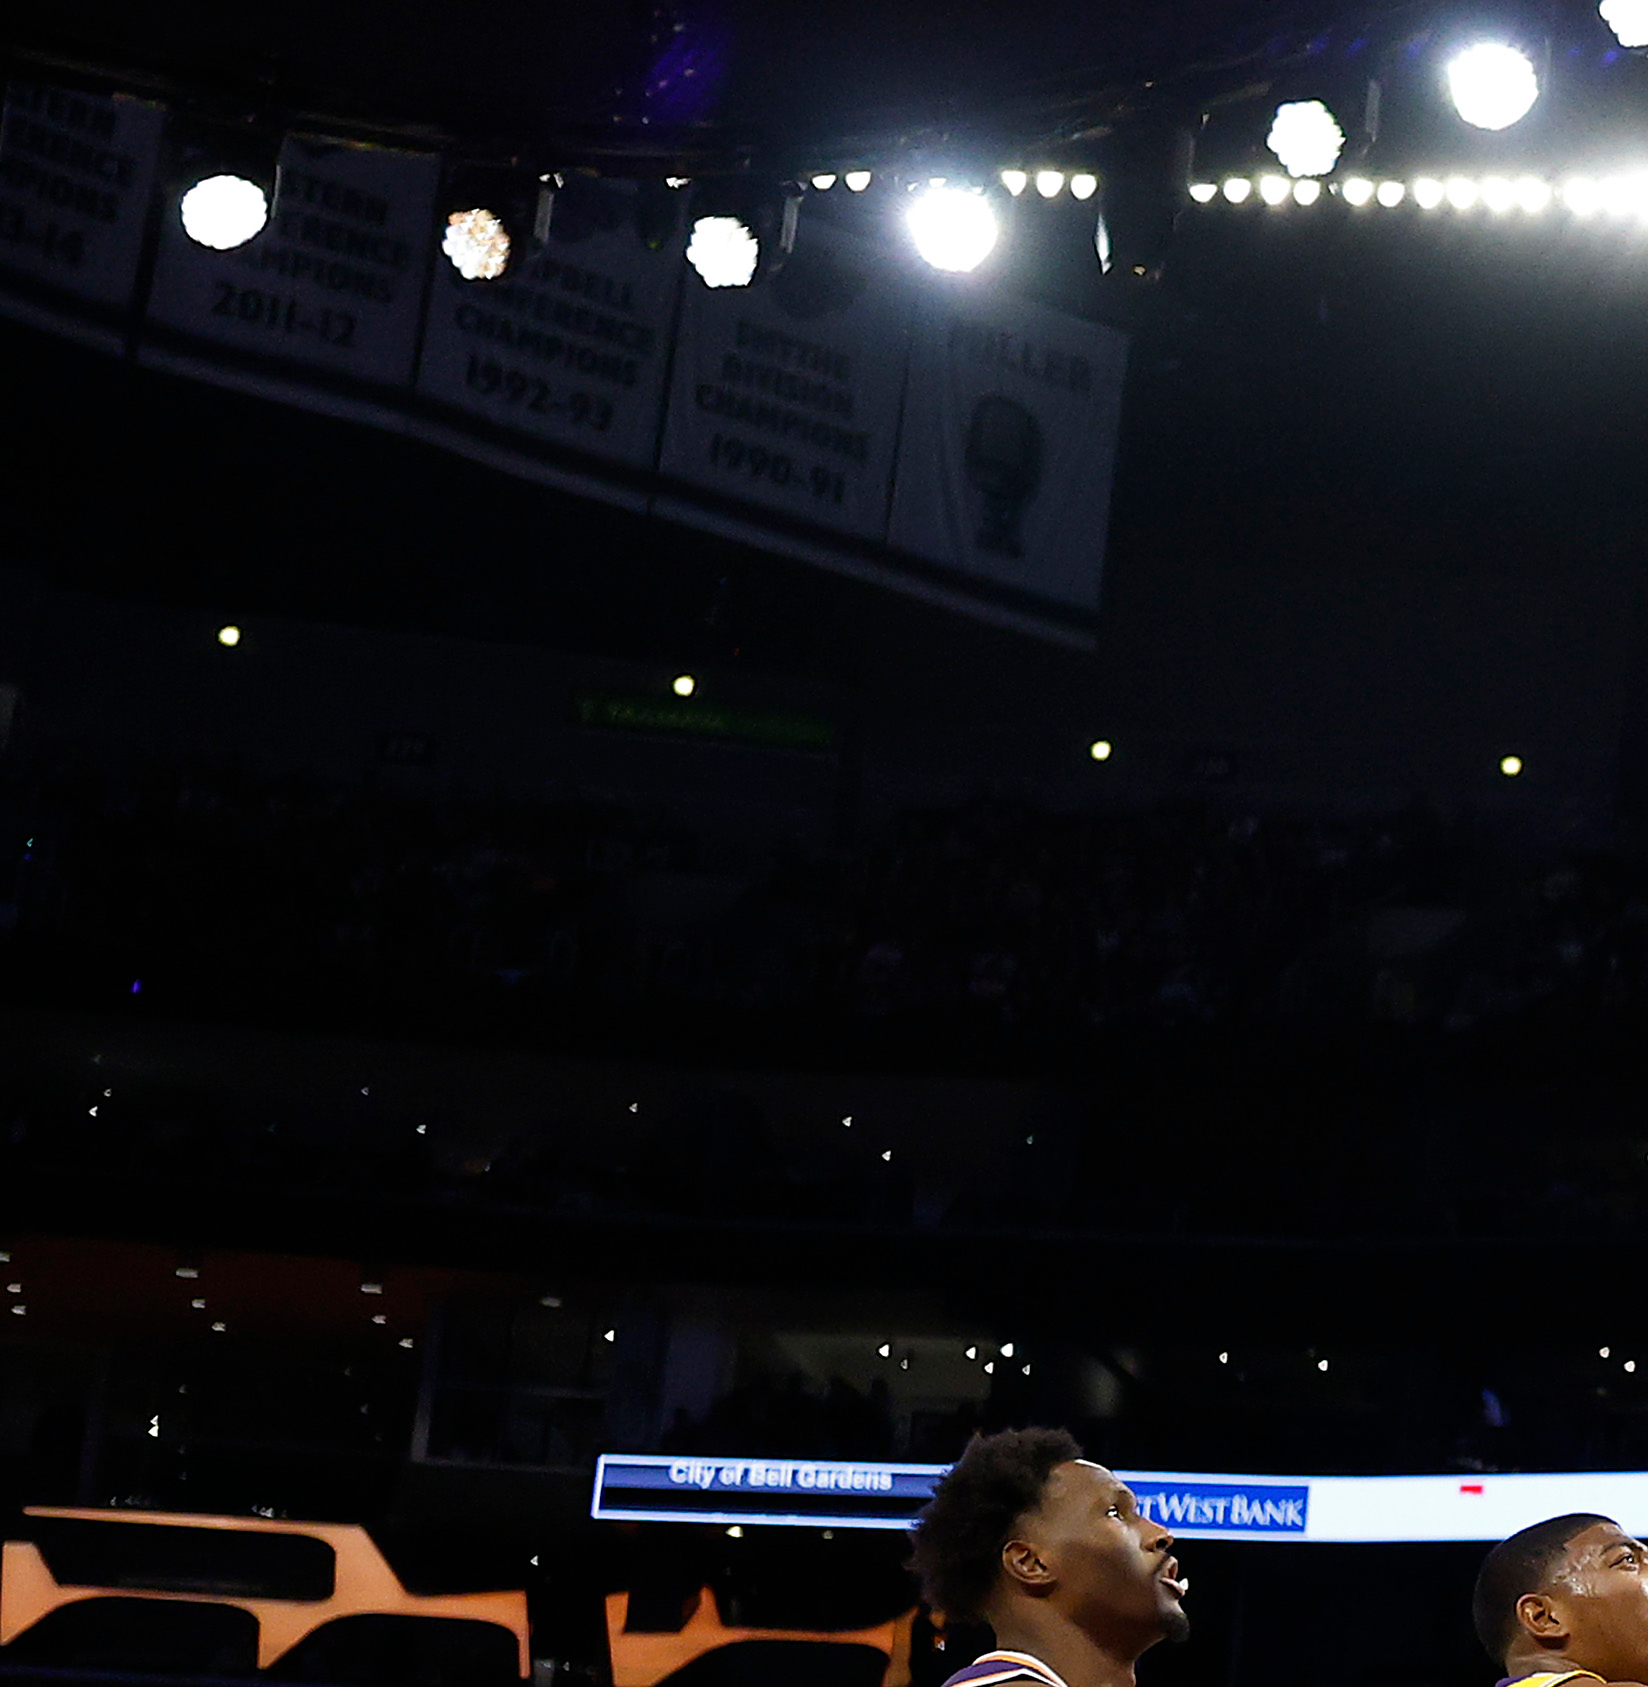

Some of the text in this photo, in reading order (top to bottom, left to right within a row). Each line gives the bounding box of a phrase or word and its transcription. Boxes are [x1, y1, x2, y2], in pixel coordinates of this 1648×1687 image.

[211, 280, 357, 349] 2011-12
[466, 354, 614, 432] 1992-93
[668, 1460, 894, 1491] City of Bell Gardens
